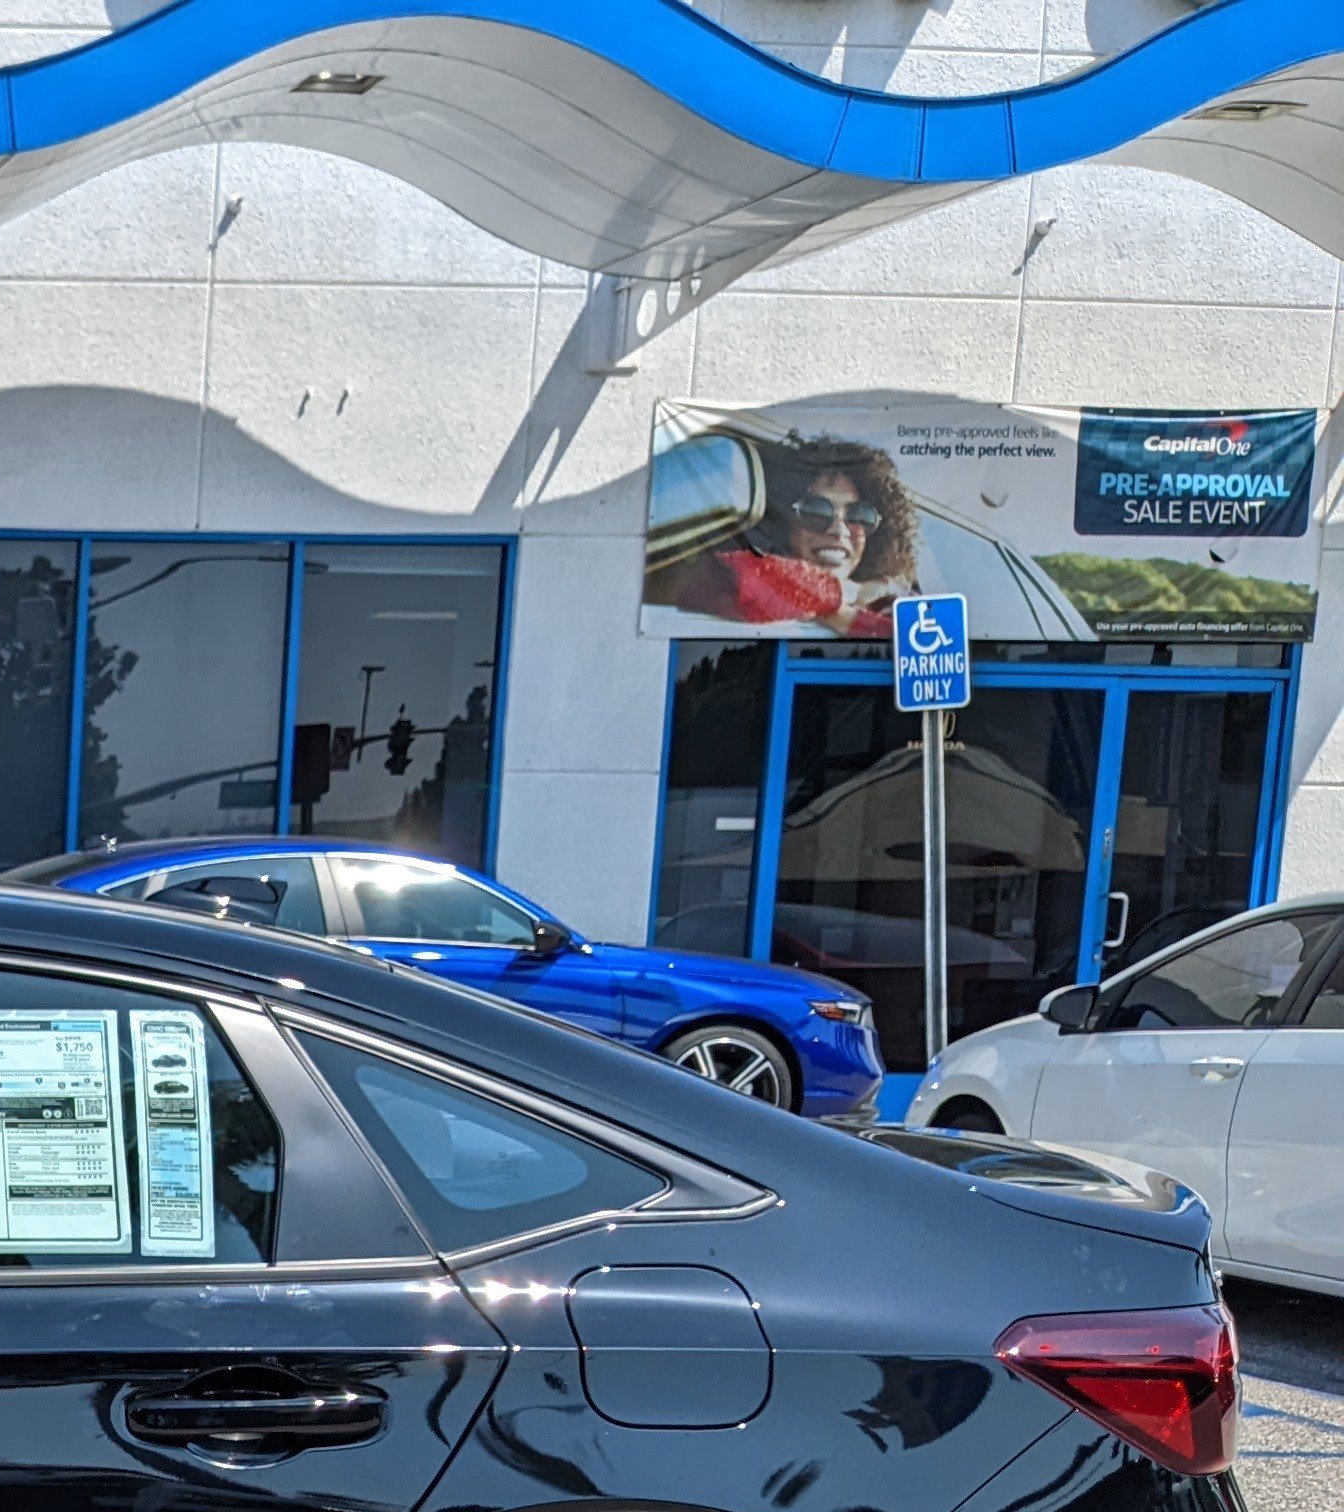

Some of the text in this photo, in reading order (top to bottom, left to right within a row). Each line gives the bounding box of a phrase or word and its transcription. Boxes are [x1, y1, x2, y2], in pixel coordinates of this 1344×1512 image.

[897, 424, 930, 439] Being
[934, 424, 1010, 440] pre-approved
[1013, 425, 1039, 439] feels
[900, 442, 1056, 458] catching the perfect view.
[1099, 472, 1291, 498] PRE-APPROVAL
[1123, 499, 1266, 524] SALE EVENT
[900, 652, 965, 678] PARKING
[912, 678, 953, 703] ONLY
